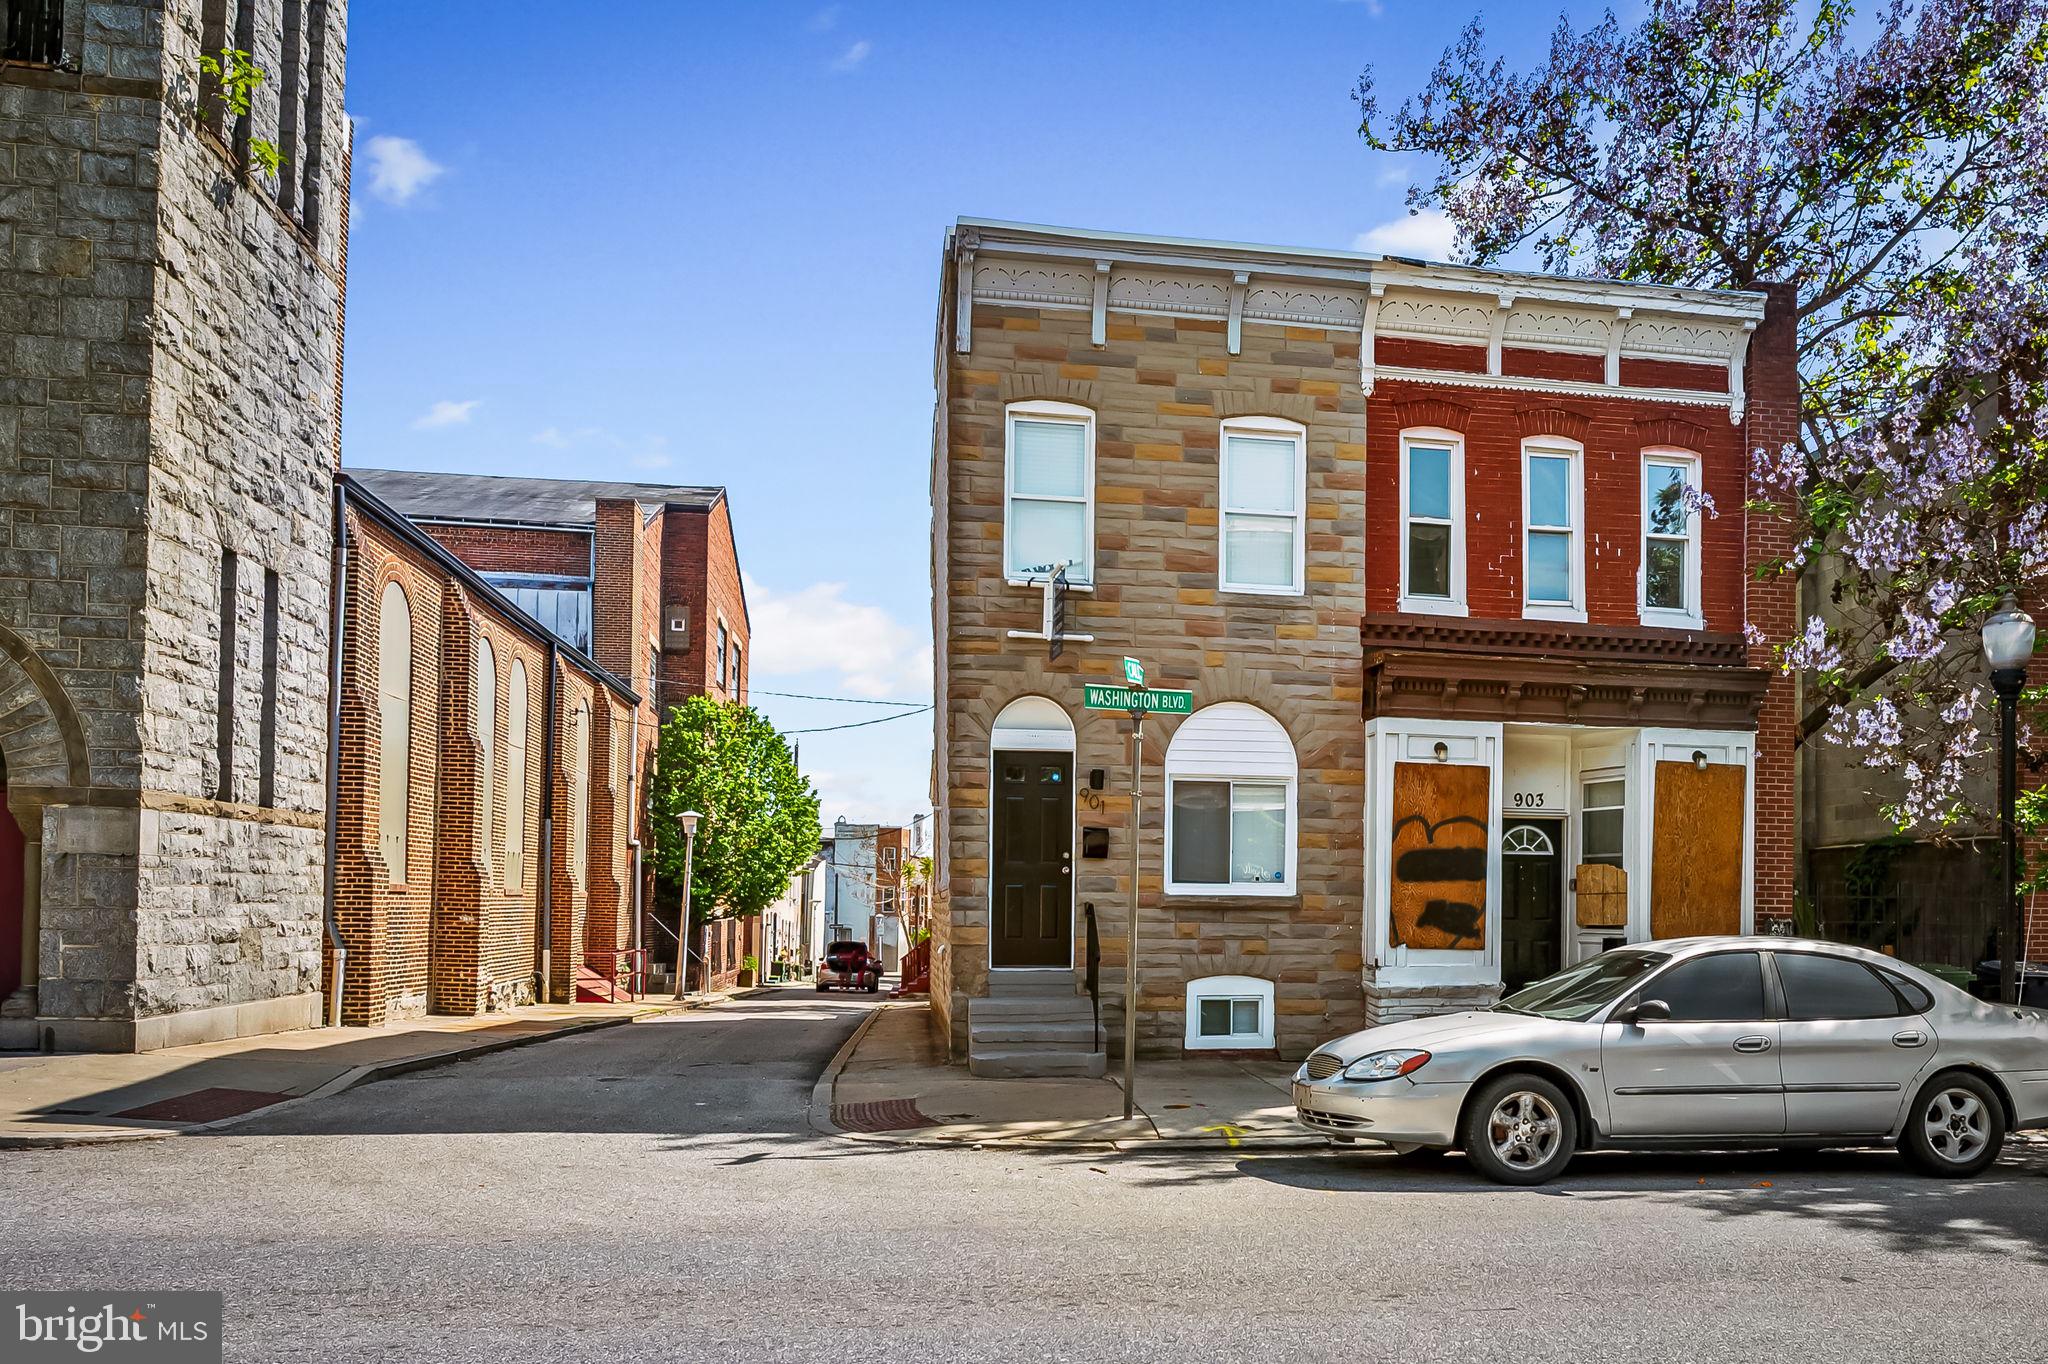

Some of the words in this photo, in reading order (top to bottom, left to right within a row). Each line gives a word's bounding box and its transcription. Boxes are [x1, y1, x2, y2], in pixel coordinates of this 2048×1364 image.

[1090, 688, 1159, 709] WASHINGTON
[1162, 695, 1186, 709] BLVD.
[1080, 788, 1105, 815] 901
[1513, 792, 1544, 808] 903
